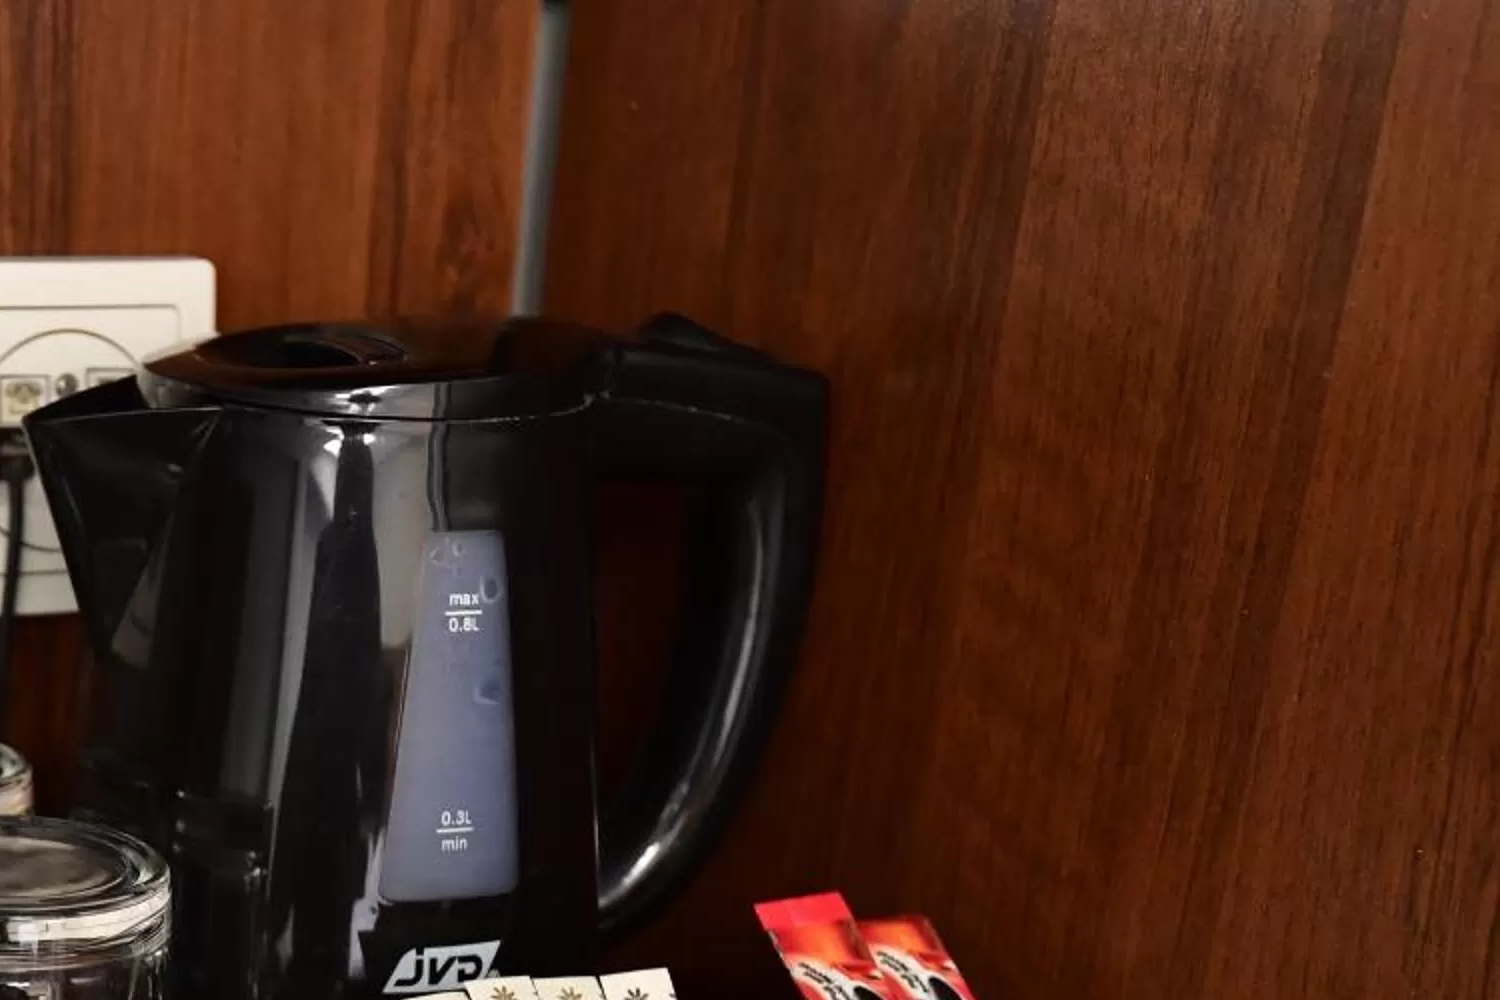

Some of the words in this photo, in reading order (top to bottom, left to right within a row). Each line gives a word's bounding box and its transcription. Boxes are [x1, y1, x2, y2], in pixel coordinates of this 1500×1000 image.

[449, 594, 479, 606] max
[441, 809, 473, 826] 0.3L
[441, 836, 468, 852] min
